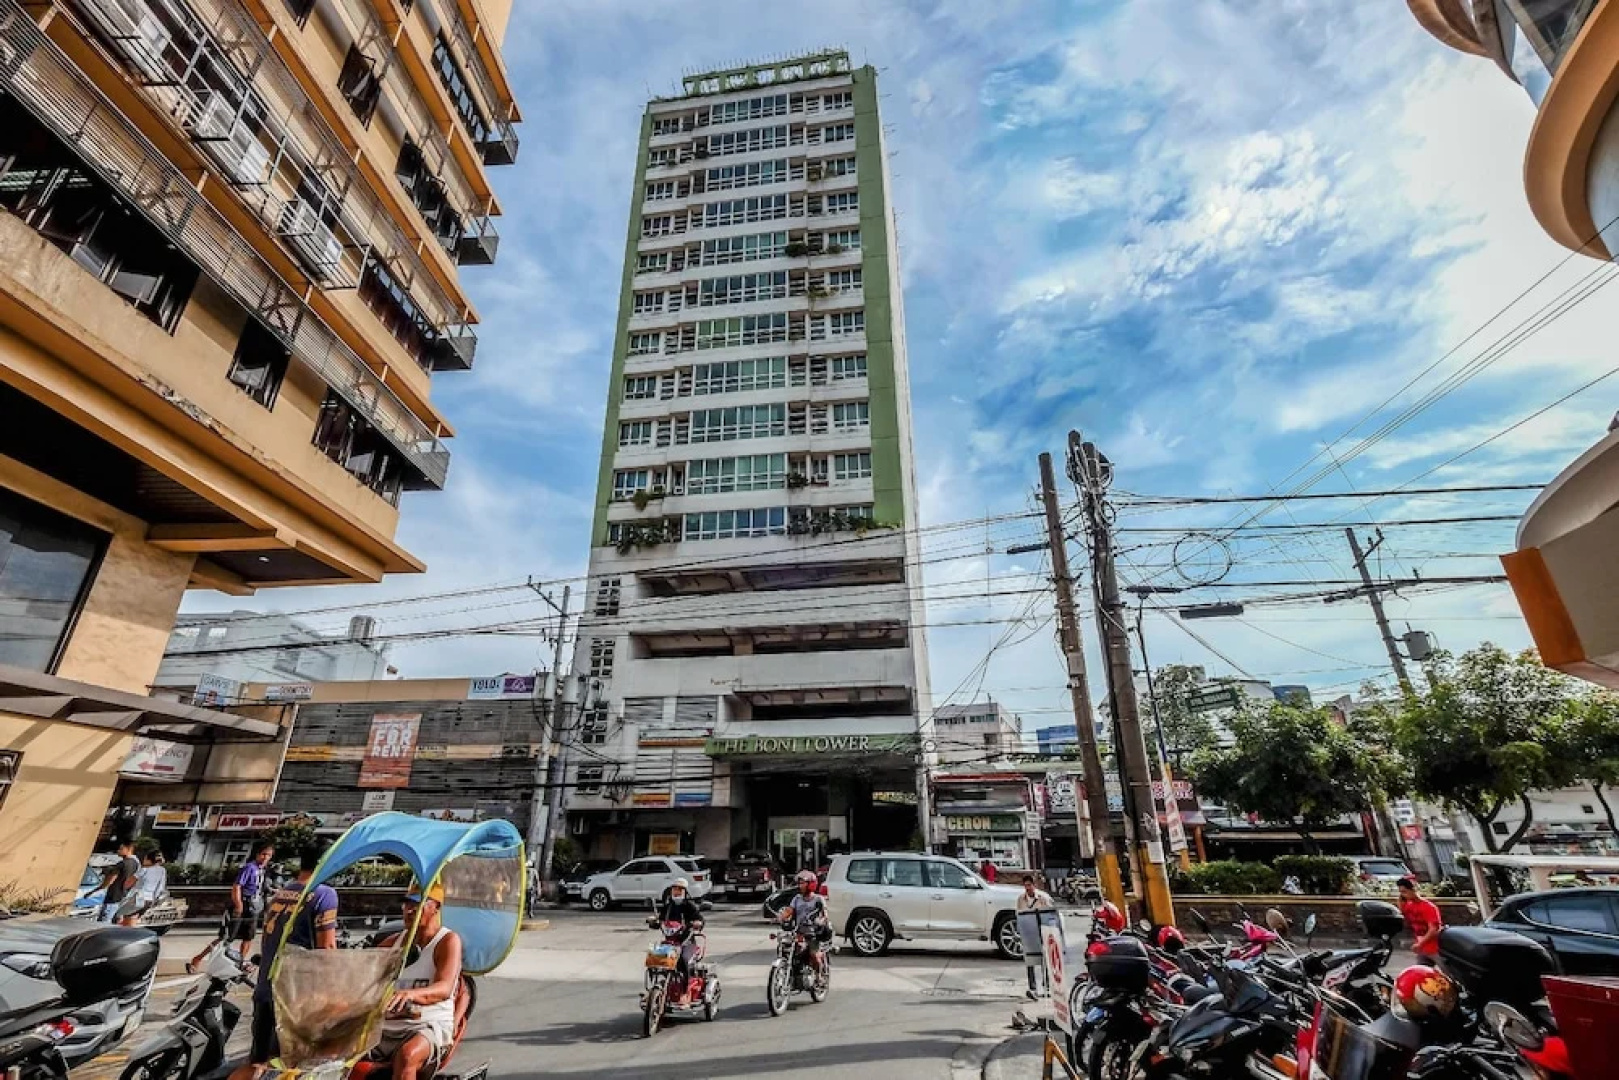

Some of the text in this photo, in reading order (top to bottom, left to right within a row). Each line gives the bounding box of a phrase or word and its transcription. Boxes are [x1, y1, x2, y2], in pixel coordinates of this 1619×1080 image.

[374, 729, 413, 746] FOR
[714, 736, 869, 753] THE BONI TOWER
[371, 744, 411, 758] RENT
